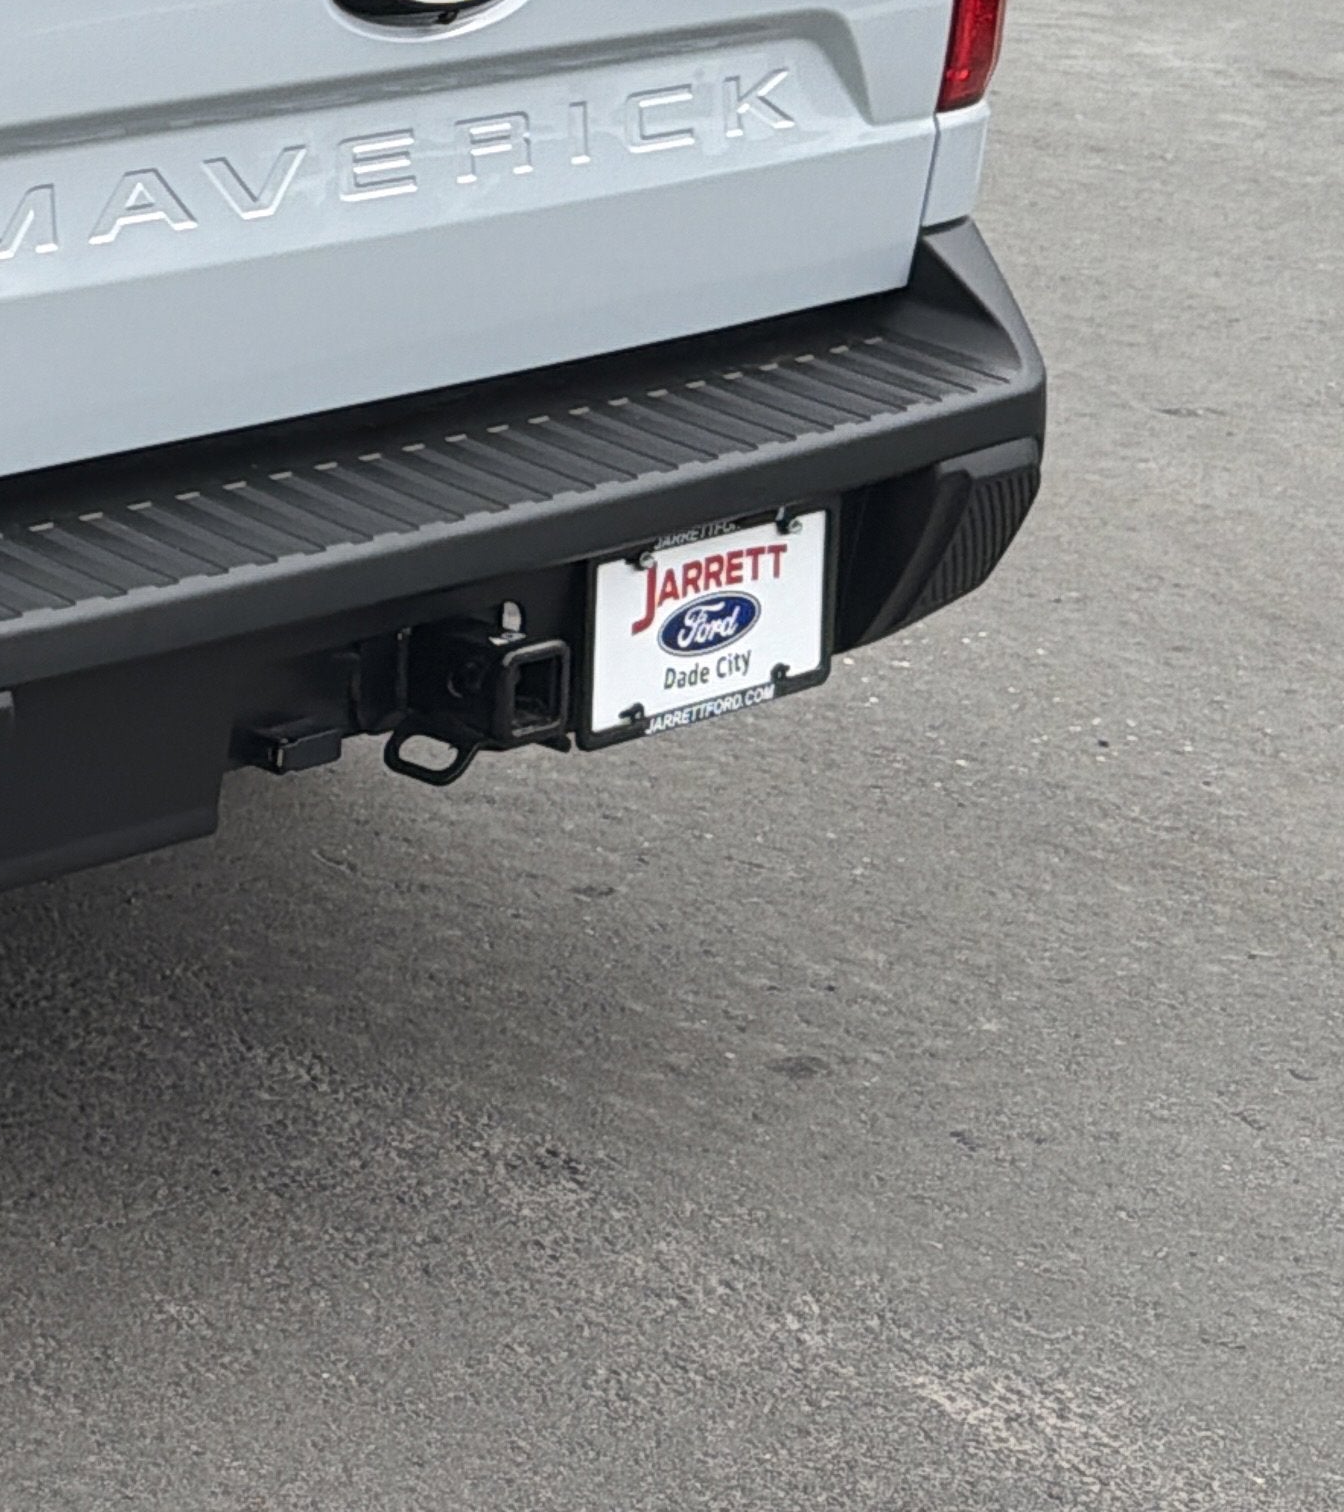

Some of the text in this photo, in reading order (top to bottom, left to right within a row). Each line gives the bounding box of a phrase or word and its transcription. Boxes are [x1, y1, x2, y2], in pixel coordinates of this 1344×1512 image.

[631, 543, 788, 637] JARRETT
[677, 600, 740, 649] Ford
[663, 650, 753, 690] Dade City
[644, 682, 775, 736] JARRETTFORD.COM
